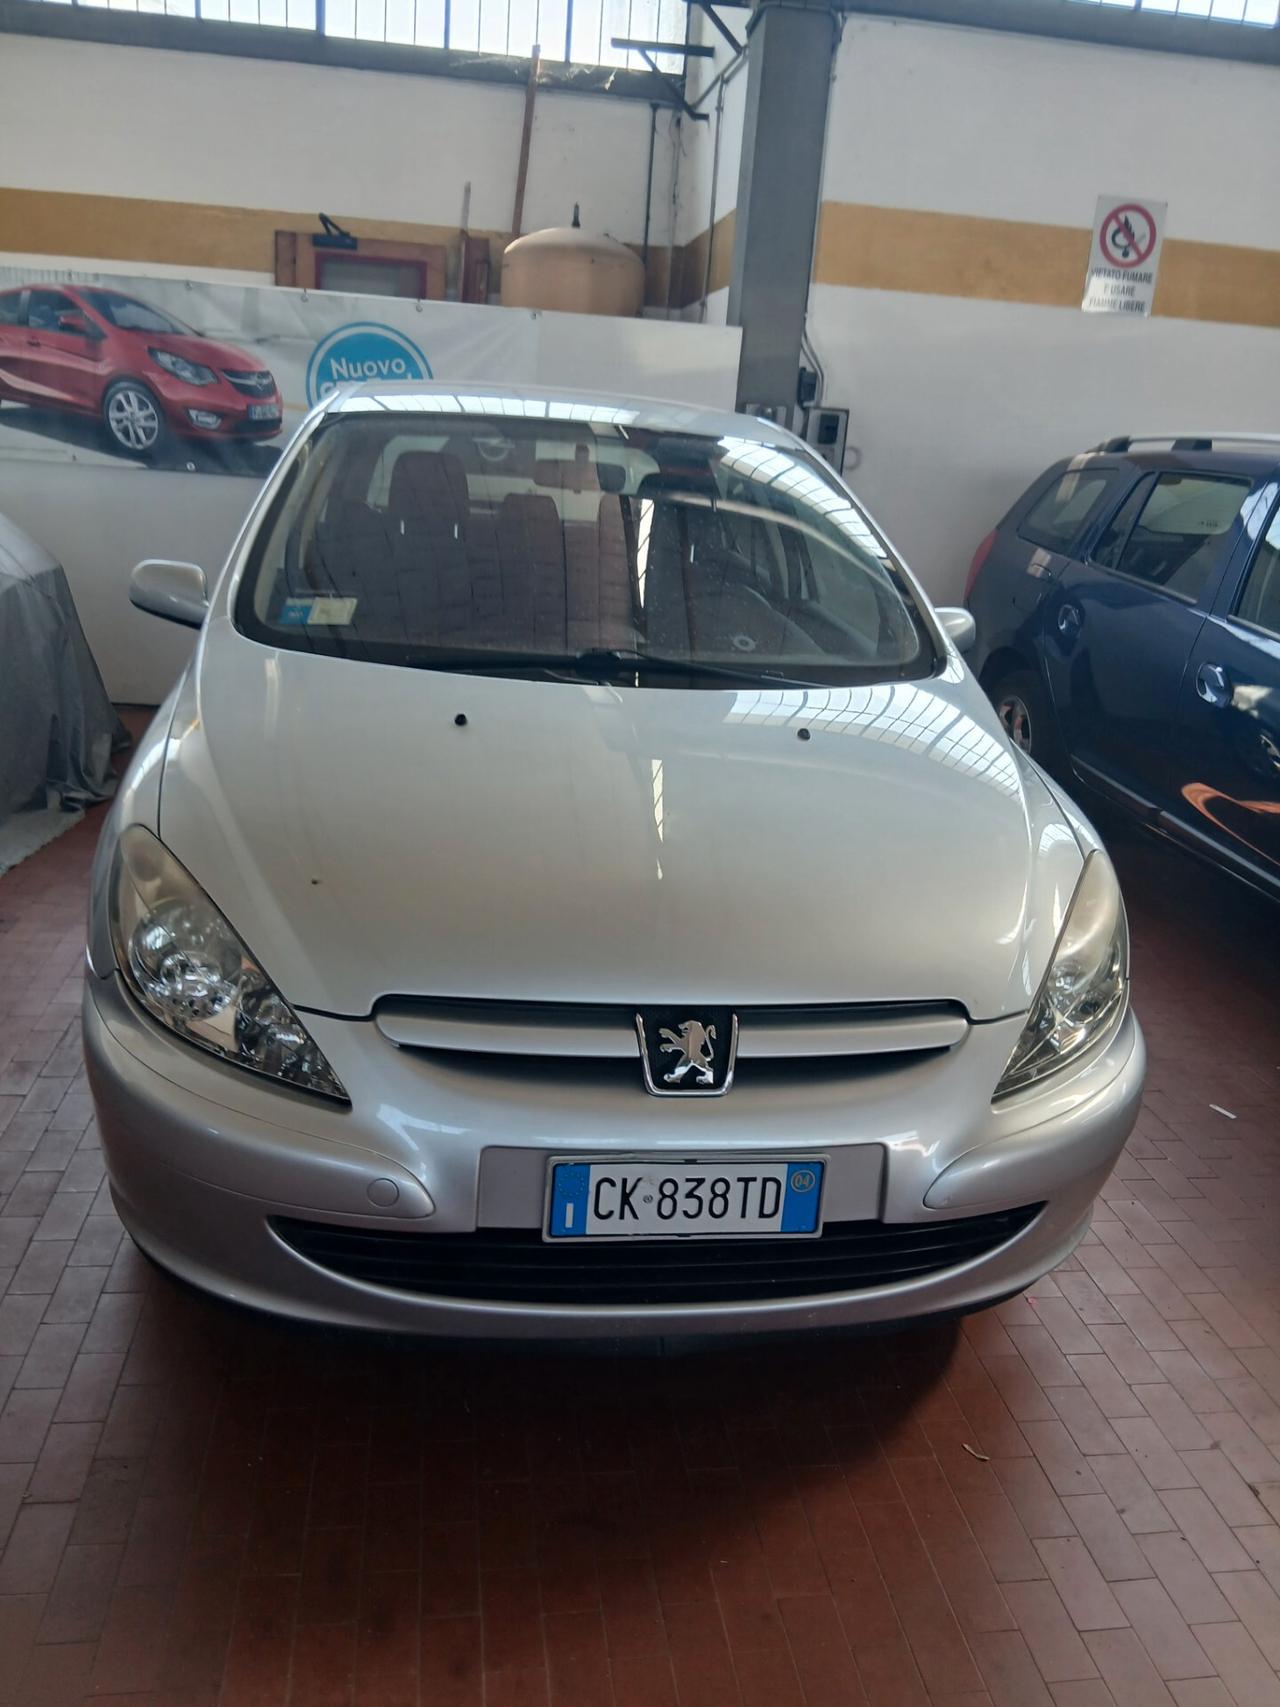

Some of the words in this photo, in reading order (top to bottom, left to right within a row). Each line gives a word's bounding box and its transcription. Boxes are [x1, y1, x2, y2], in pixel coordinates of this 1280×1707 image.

[330, 357, 406, 380] Nuovo
[593, 1176, 643, 1220] CK
[656, 1176, 782, 1220] 838TD
